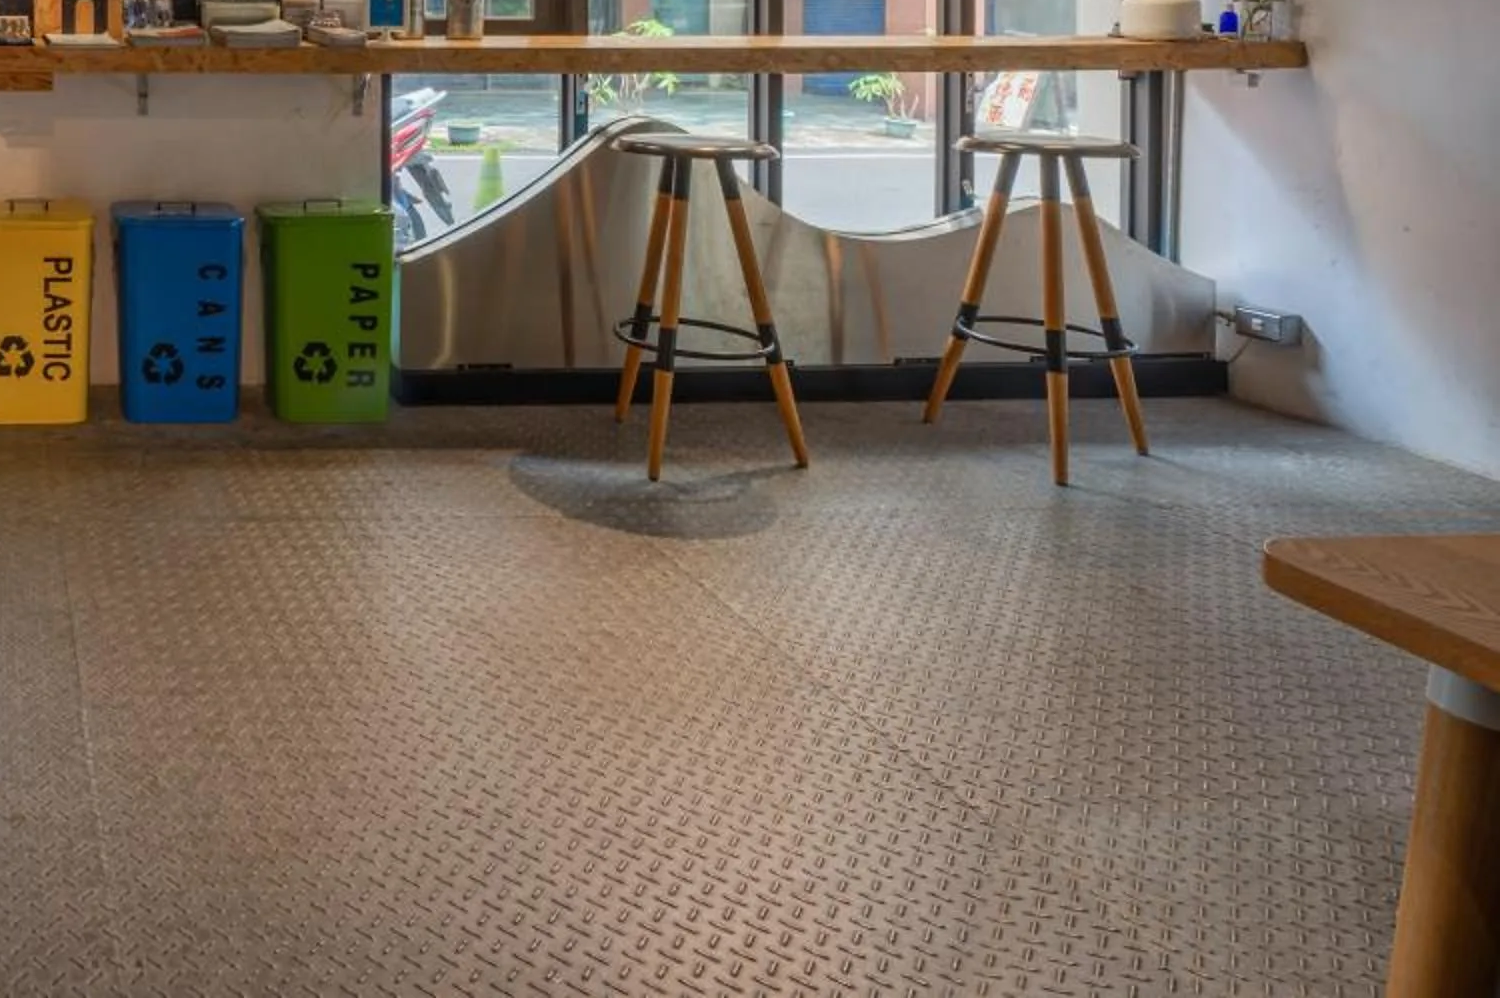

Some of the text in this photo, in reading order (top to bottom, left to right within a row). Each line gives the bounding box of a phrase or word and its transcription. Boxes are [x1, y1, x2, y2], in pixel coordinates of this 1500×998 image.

[42, 256, 73, 381] PLASTIC
[195, 264, 228, 390] CANS
[347, 263, 380, 388] PAPER
